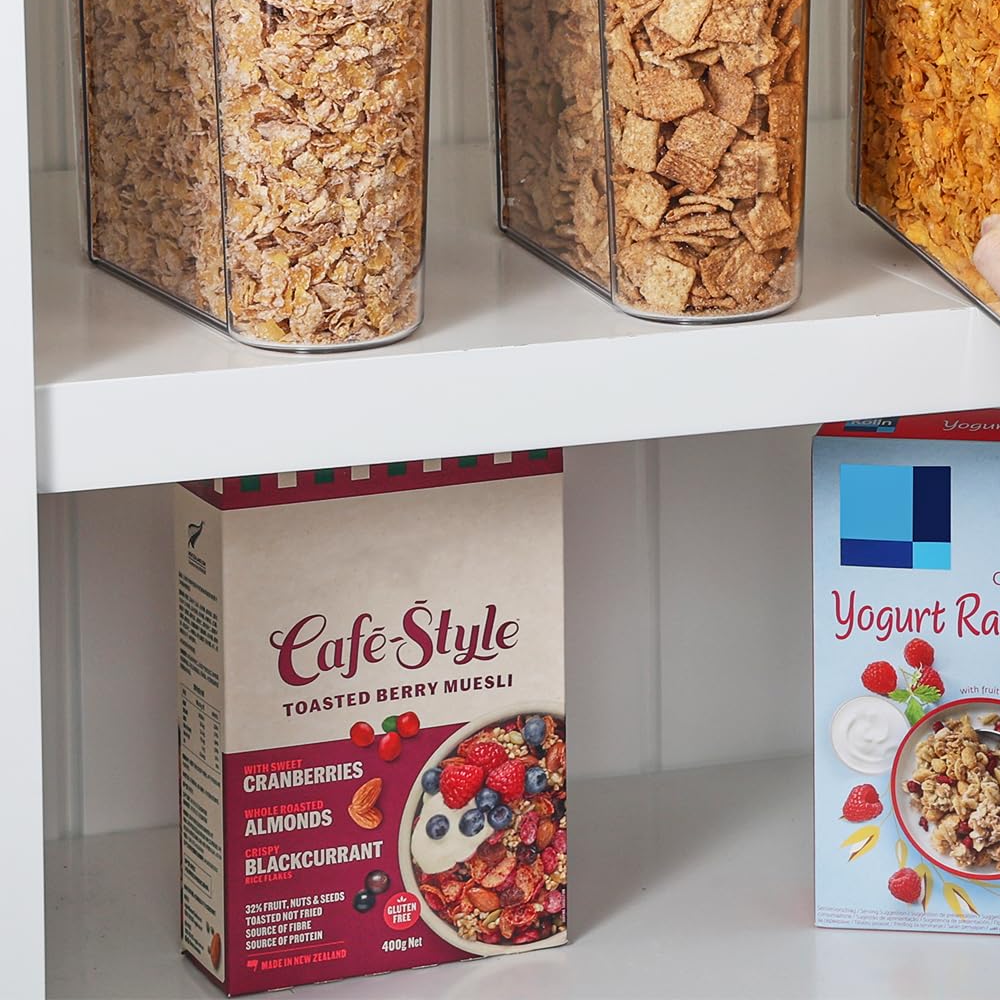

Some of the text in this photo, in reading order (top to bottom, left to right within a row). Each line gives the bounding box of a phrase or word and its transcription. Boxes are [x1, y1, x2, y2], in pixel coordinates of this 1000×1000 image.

[831, 590, 946, 642] Yogurt
[282, 674, 513, 717] TOASTED BERRY MUESLI
[960, 686, 980, 695] with
[243, 761, 364, 793] CRANBERRIES
[244, 760, 303, 775] WITH SWEET
[244, 800, 324, 819] WHOLE ROASTED
[244, 808, 333, 837] ALMONDS
[244, 844, 280, 858] CRISPY
[245, 840, 384, 876] BLACKCURRANT
[244, 871, 293, 885] RICE FLAKES
[245, 904, 262, 914] 32%
[290, 896, 312, 908] NUTS
[312, 896, 320, 904] &
[320, 892, 345, 904] SEEDS
[387, 902, 417, 915] GLUTEN
[246, 907, 323, 926] TOASTED NOT FRIED
[392, 912, 412, 924] FREE
[246, 920, 312, 938] SOURCE OF FIBRE
[246, 930, 323, 950] SOURCE OF PROTEIN
[382, 936, 422, 952] 400g Net
[261, 950, 347, 970] MADE IN NEW ZEALAND
